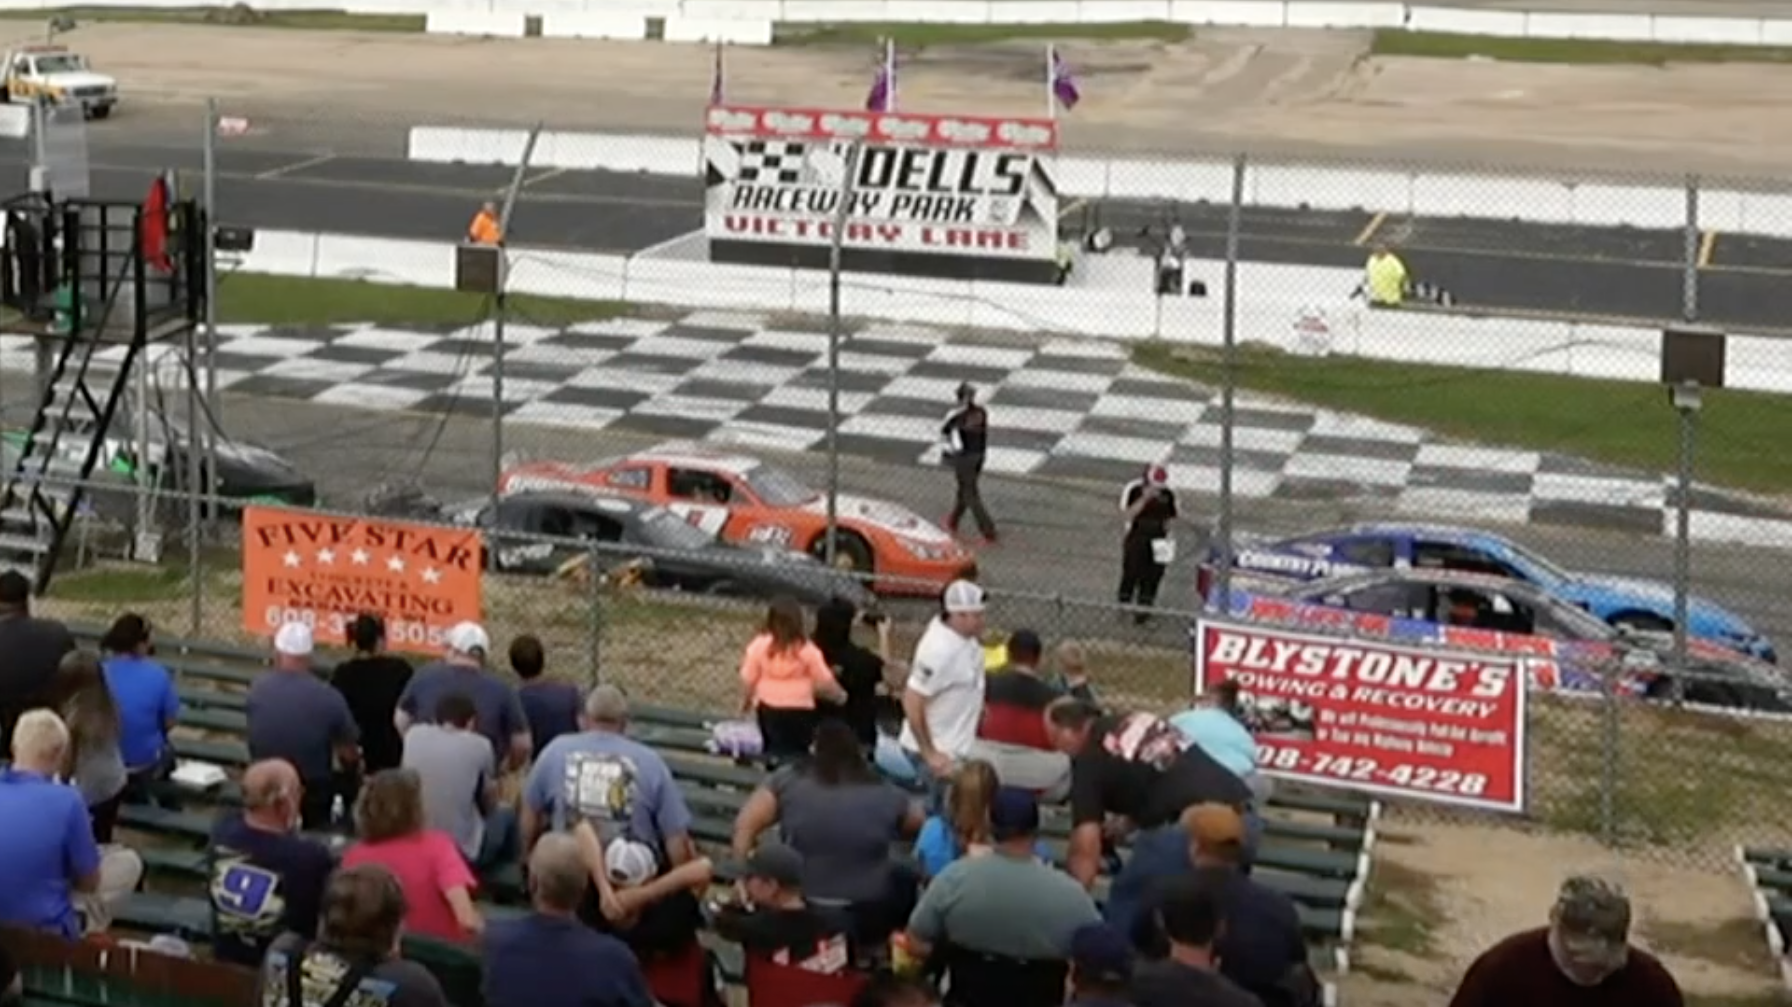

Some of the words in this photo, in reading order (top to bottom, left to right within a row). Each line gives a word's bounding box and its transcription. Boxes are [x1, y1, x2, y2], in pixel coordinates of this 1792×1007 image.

[859, 147, 1028, 196] DELLS
[890, 194, 977, 222] PARK
[922, 227, 1028, 250] LANE
[257, 520, 356, 548] FIVE
[365, 525, 473, 571] STAR
[267, 577, 454, 615] EXCAVATING
[1209, 631, 1512, 698] BLYSTONE'S
[1223, 668, 1327, 697] TOWING
[1328, 683, 1349, 701] &
[1352, 686, 1498, 719] RECOVERY
[1256, 744, 1488, 796] 08-742-4228
